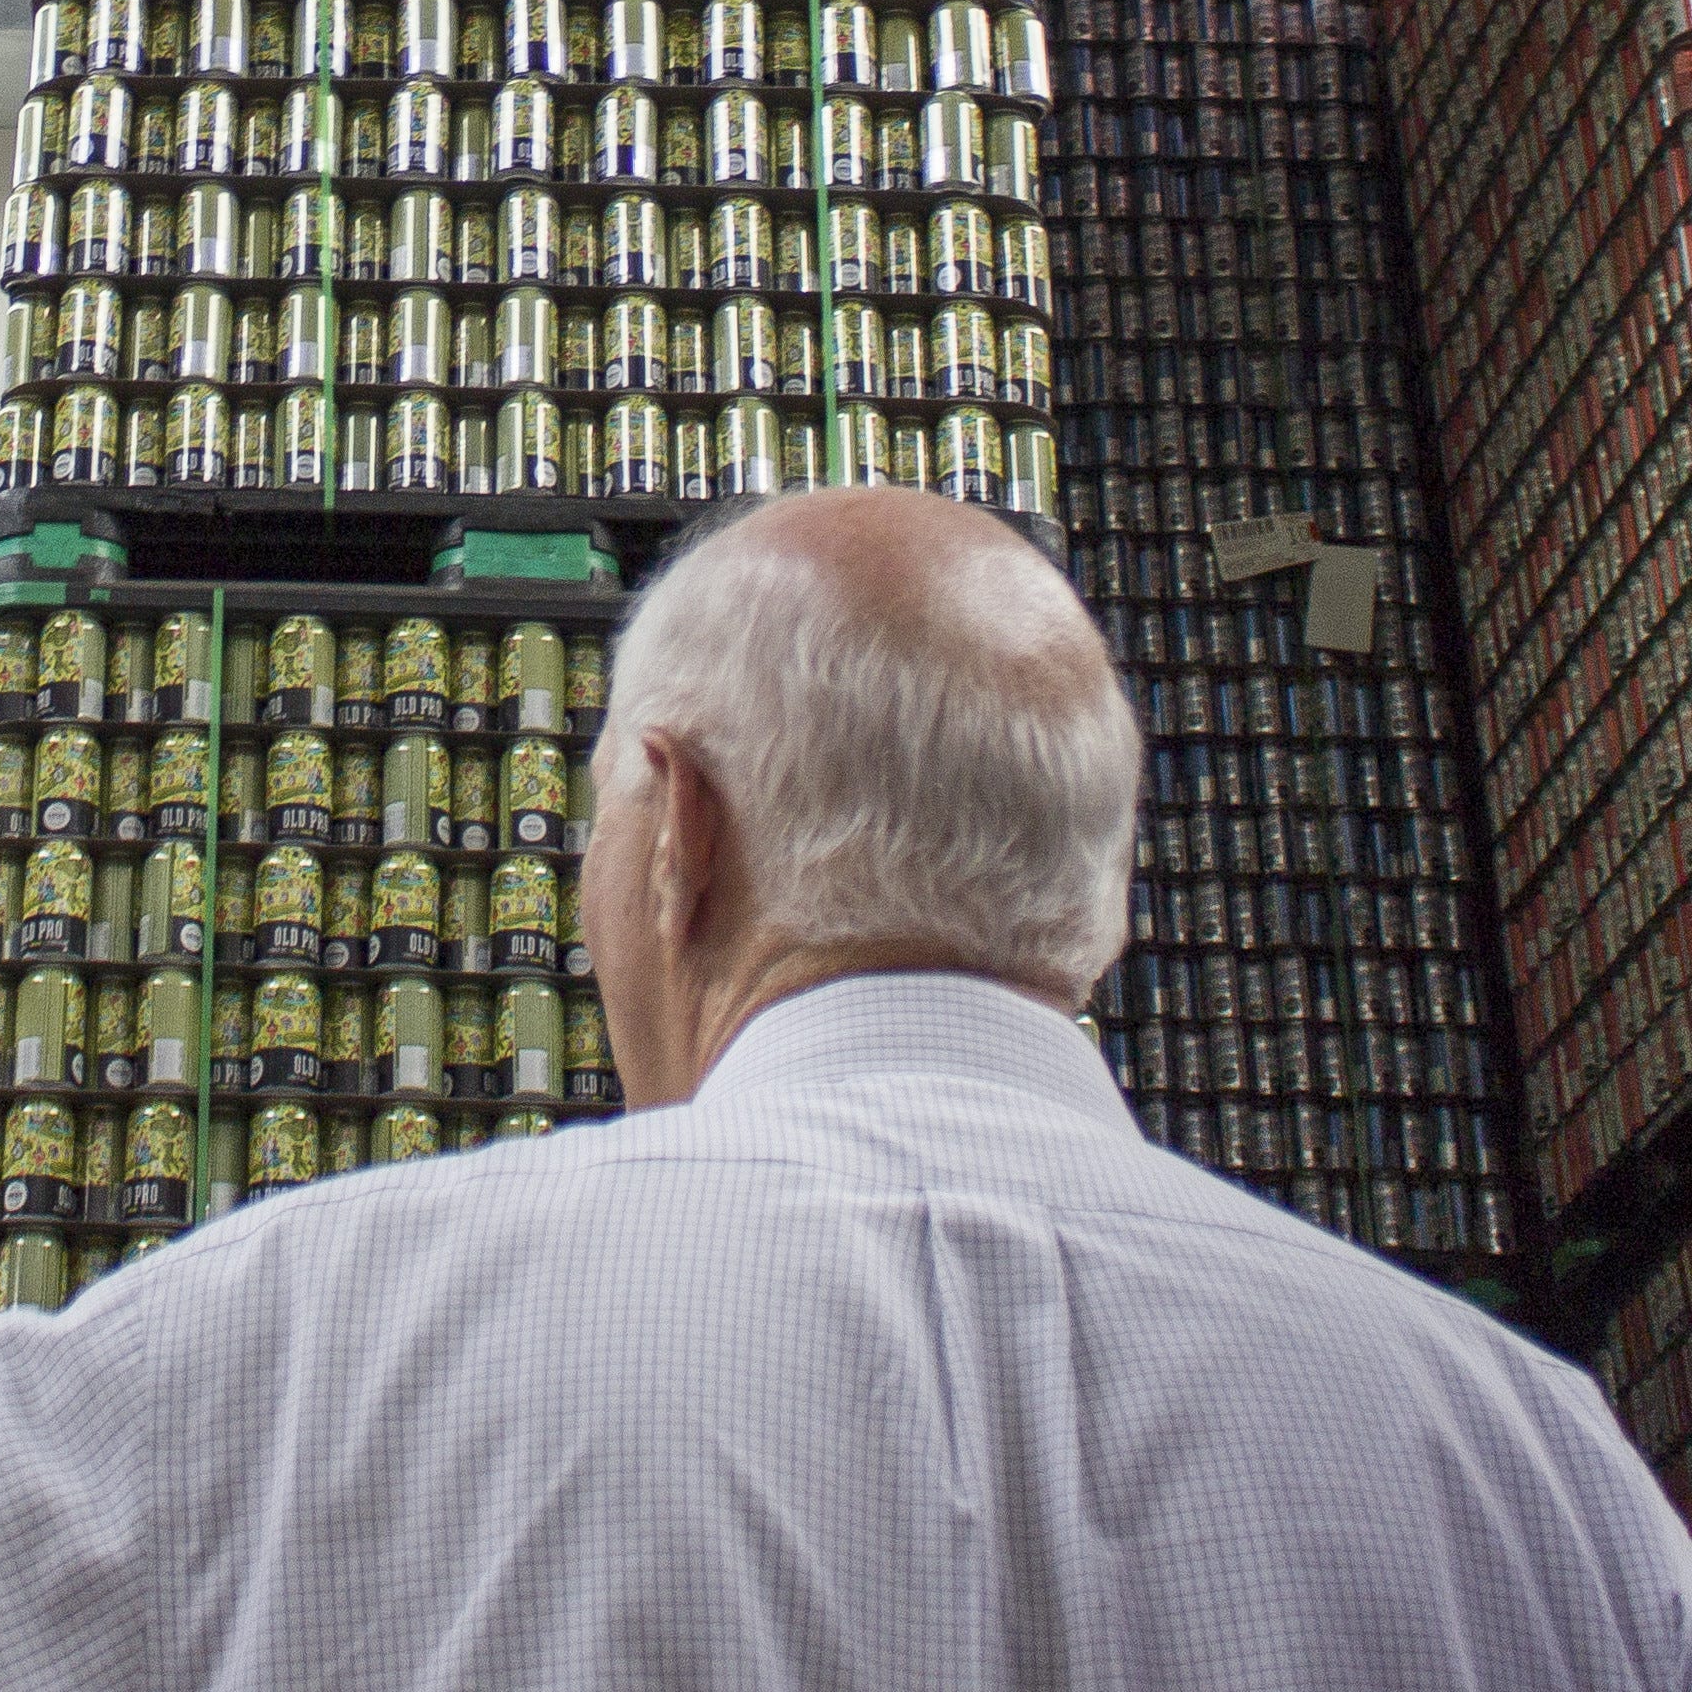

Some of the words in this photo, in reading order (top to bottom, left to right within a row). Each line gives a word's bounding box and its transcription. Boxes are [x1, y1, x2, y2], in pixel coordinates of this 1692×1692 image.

[394, 696, 417, 716] OLD
[161, 808, 183, 828] OLD
[283, 809, 306, 830] OLD
[38, 920, 64, 940] PRO
[274, 927, 298, 947] OLD
[511, 934, 536, 955] OLD
[134, 1183, 159, 1205] PRO
